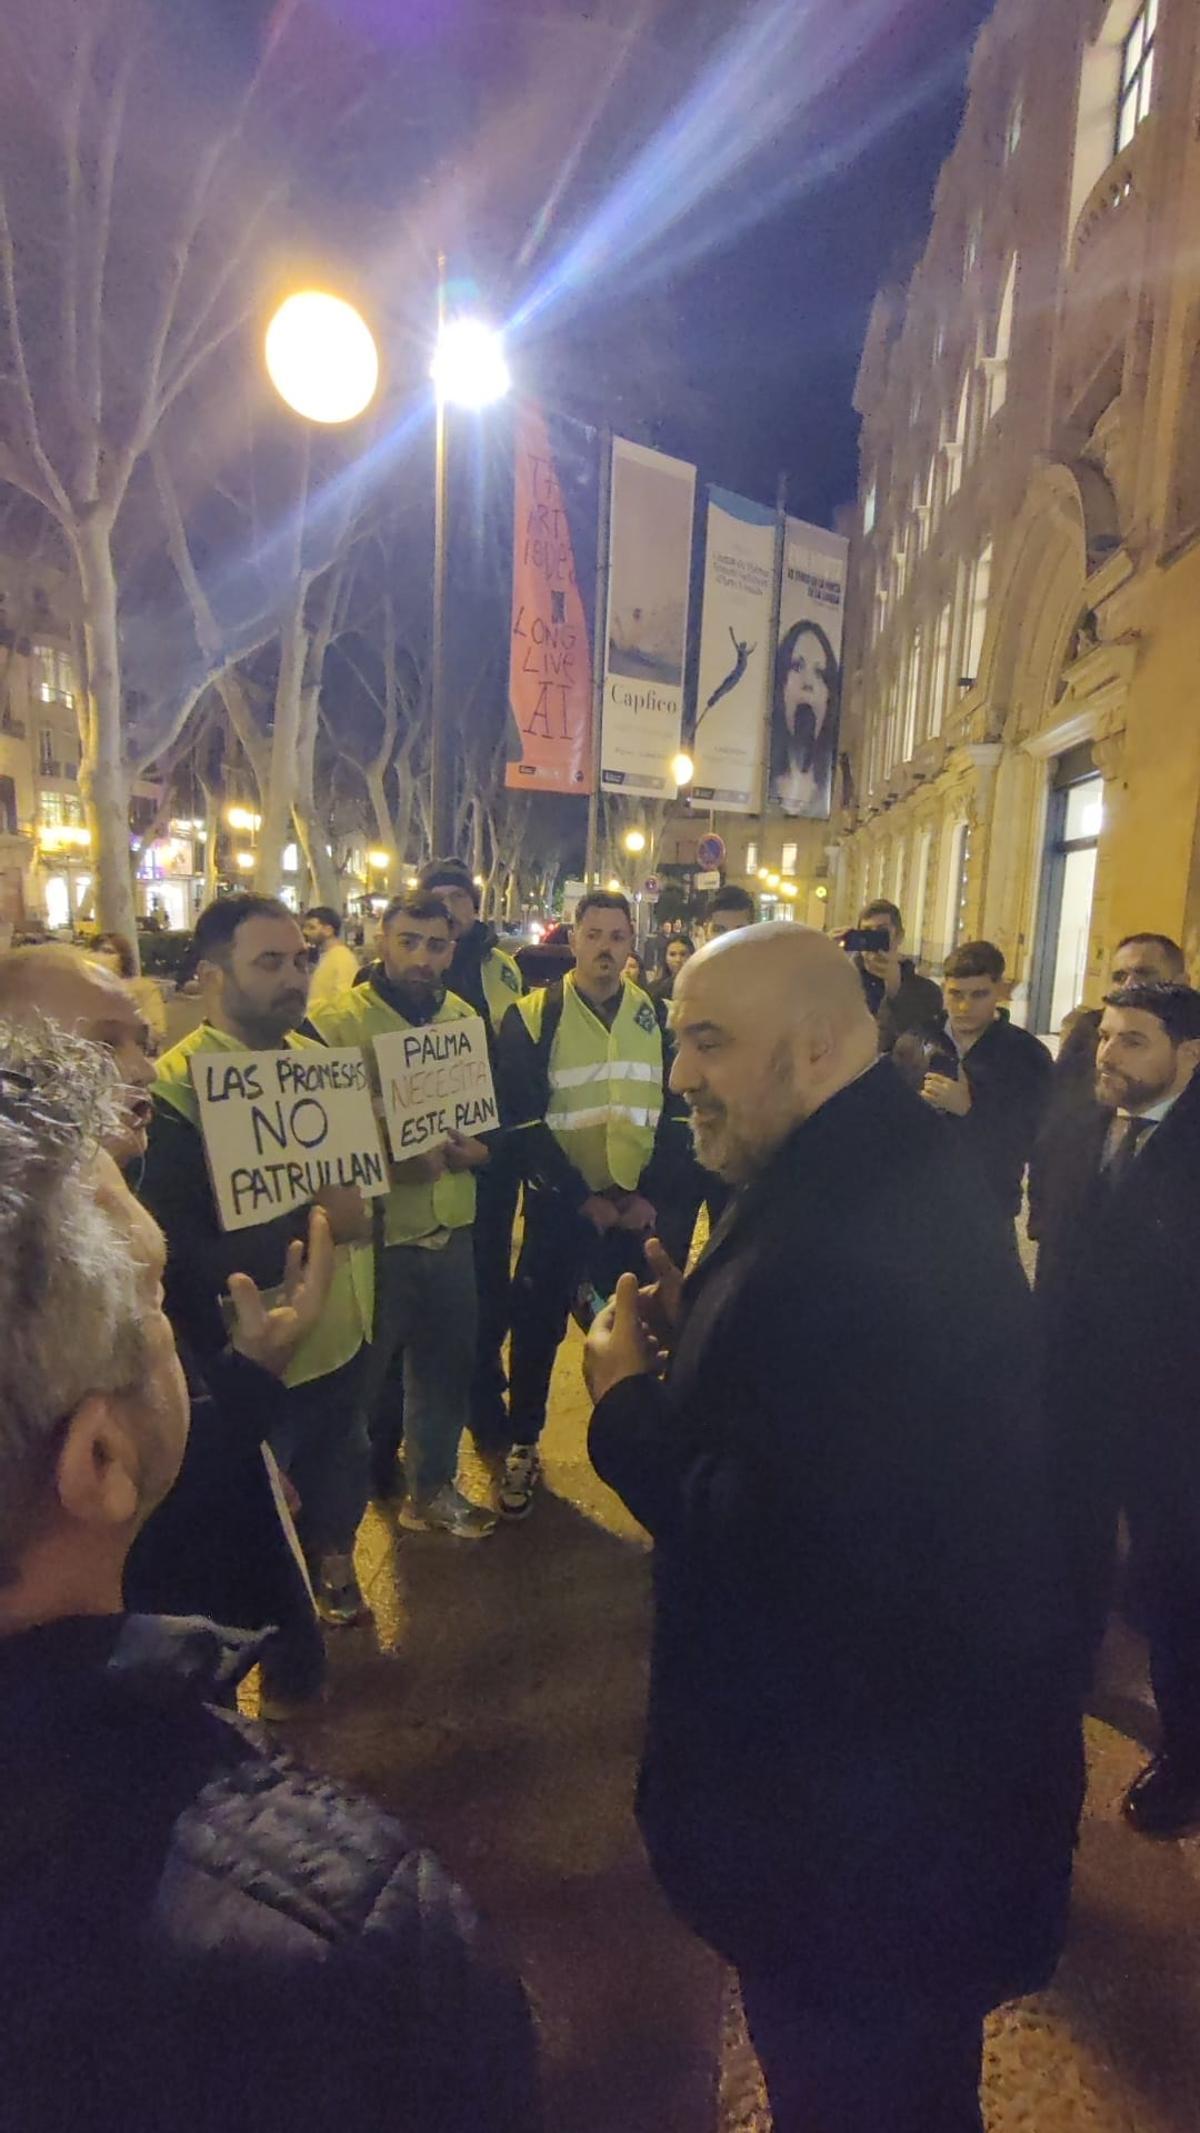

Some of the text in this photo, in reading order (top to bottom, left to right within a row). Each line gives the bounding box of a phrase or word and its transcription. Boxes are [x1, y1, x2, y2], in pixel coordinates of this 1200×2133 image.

[513, 605, 576, 650] LONG
[522, 646, 576, 685] LIVE
[522, 680, 574, 740] AI
[404, 1032, 472, 1068] PALMA
[206, 1064, 264, 1102] LAS
[391, 1060, 487, 1113] NECESITA
[252, 1098, 328, 1155] NO
[401, 1097, 496, 1147] ESTE PLAN
[231, 1153, 382, 1215] PATRULLAN
